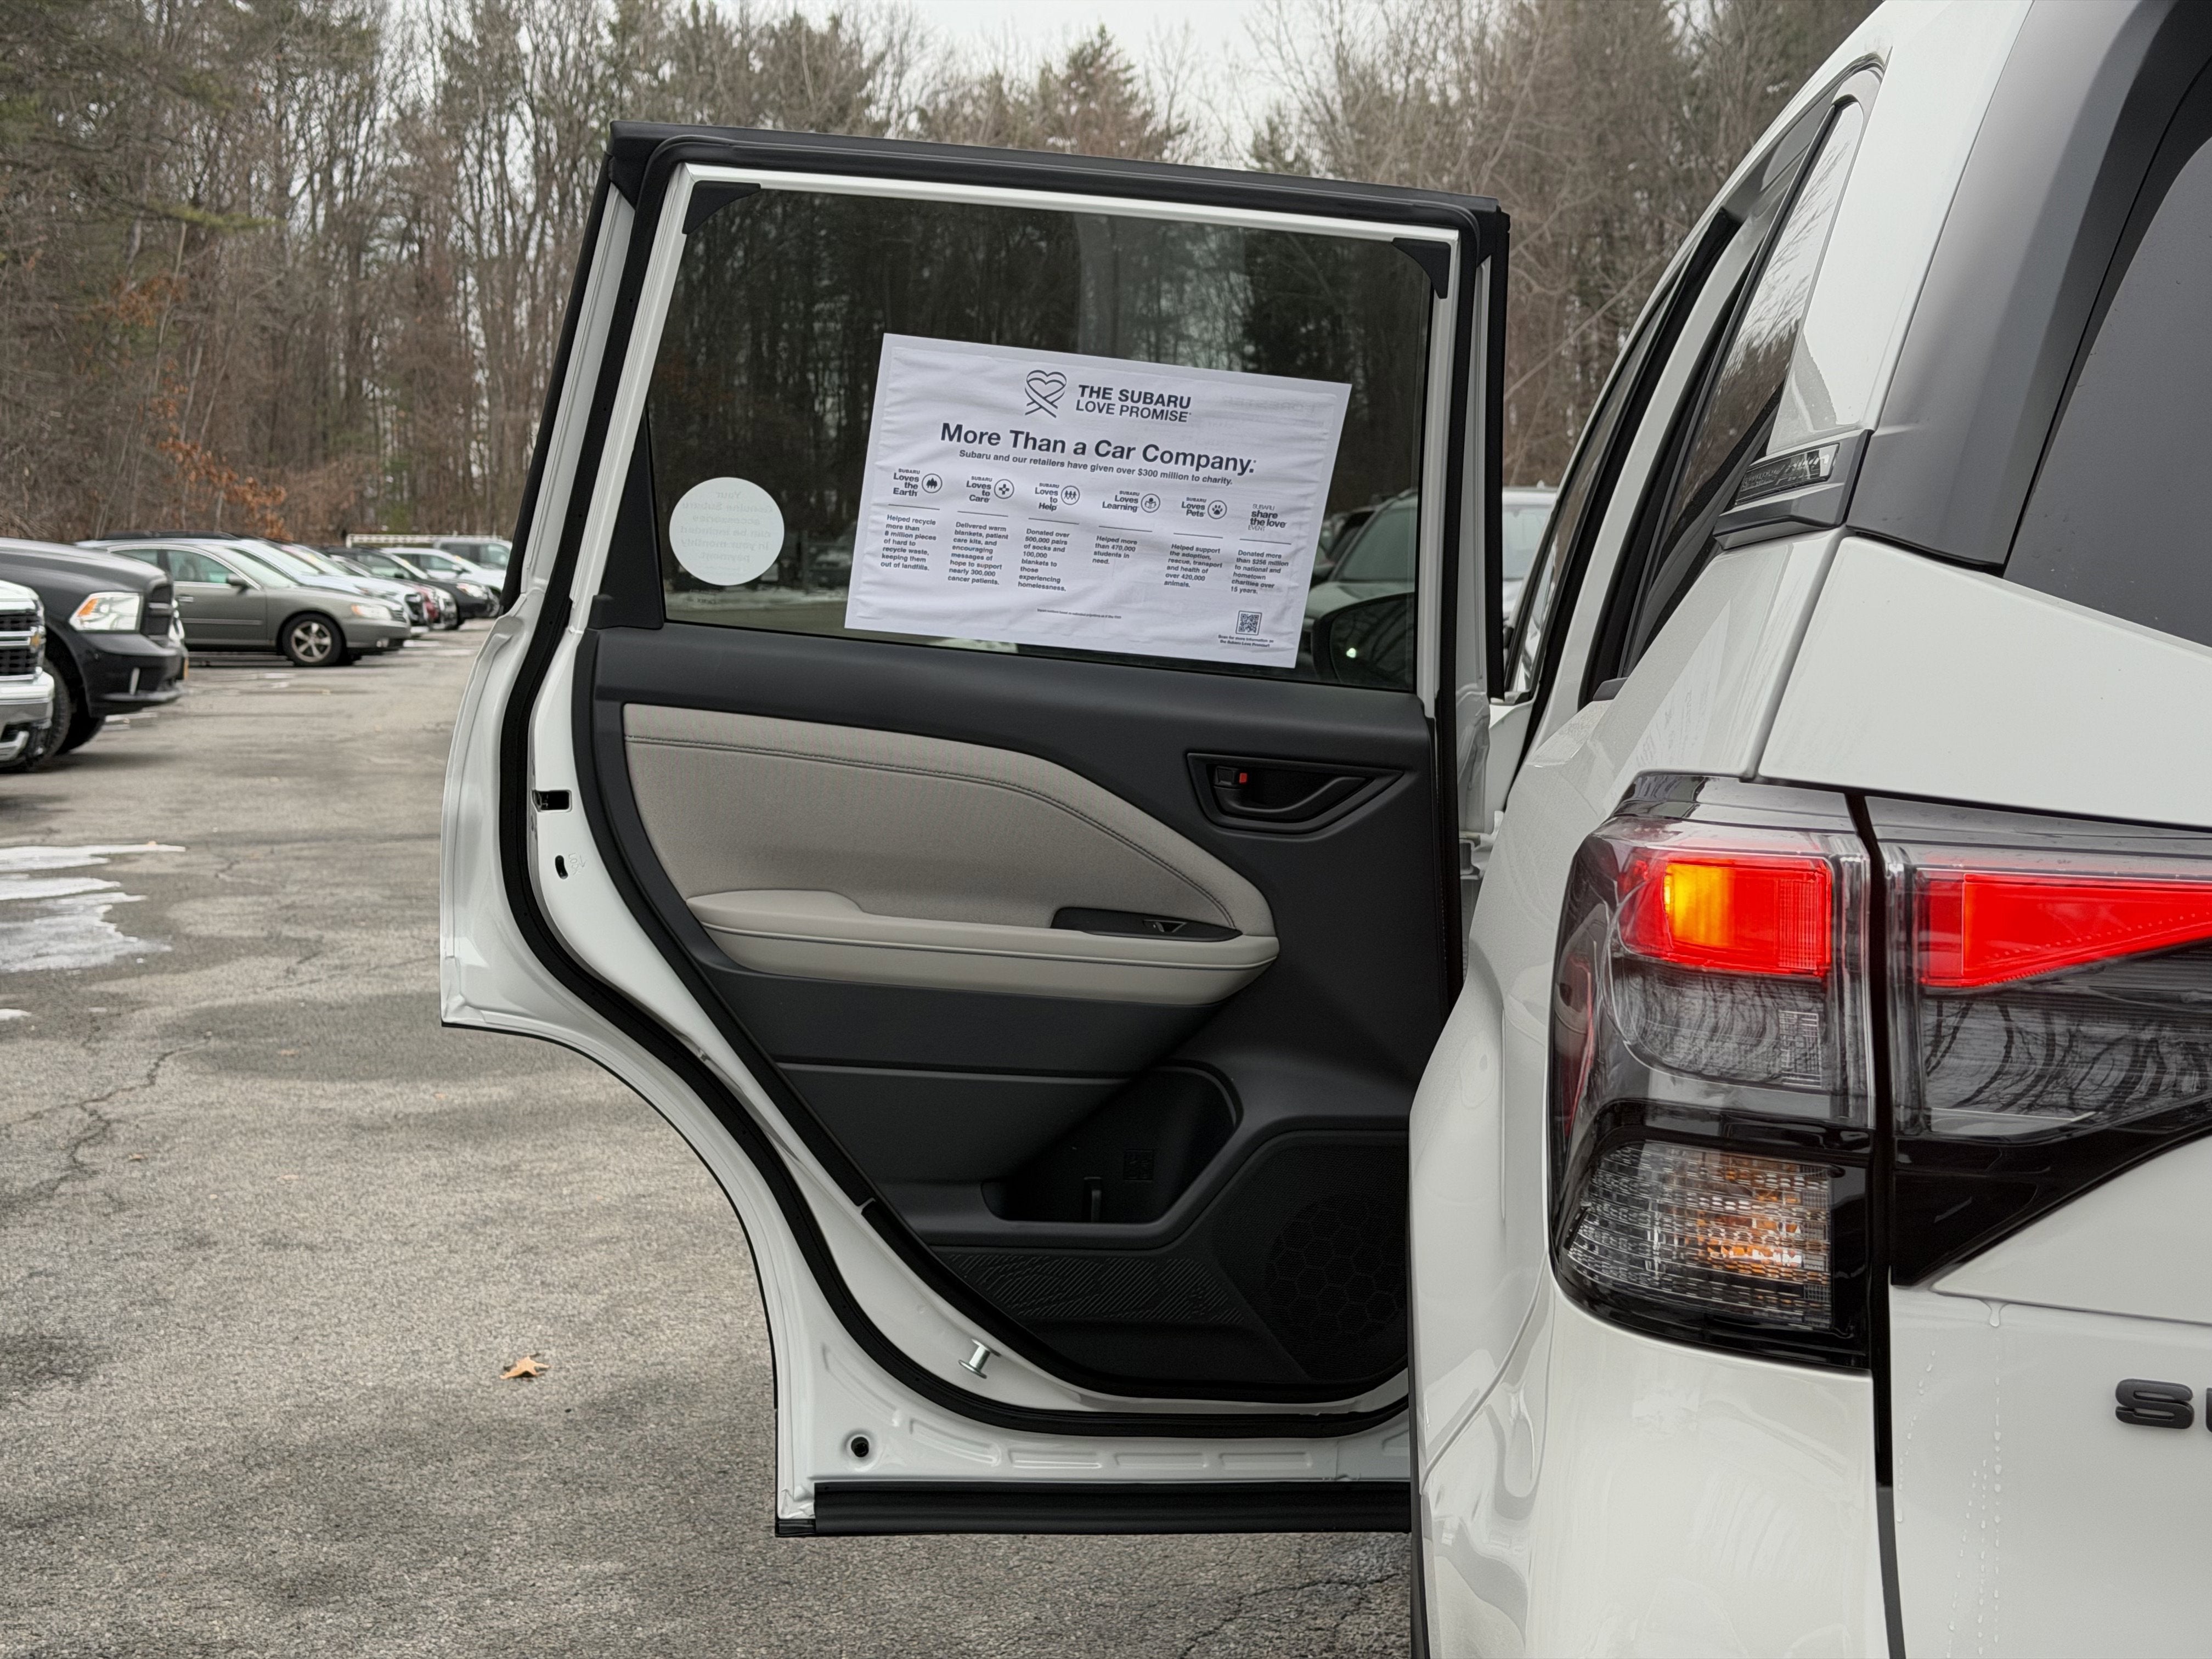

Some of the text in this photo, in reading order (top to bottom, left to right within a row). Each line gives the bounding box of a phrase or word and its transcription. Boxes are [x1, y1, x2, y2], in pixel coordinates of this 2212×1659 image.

[1078, 384, 1191, 409] THE SUBARU
[1075, 399, 1188, 422] LOVE PROMISE
[940, 422, 1001, 446] More
[1009, 430, 1066, 454] Than
[1073, 442, 1087, 455] a
[1094, 439, 1136, 460] Car
[959, 449, 991, 460] Subaru
[1029, 458, 1065, 467] retailers
[1066, 460, 1088, 470] have
[1090, 463, 1114, 472] given
[1116, 467, 1136, 475] over
[1137, 468, 1158, 477] $300
[1160, 471, 1189, 481] million
[1201, 475, 1232, 486] charity.
[893, 472, 919, 482] Loves
[904, 481, 918, 489] the
[966, 480, 991, 490] Loves
[893, 487, 918, 497] Earth
[1035, 487, 1058, 496] Loves
[969, 494, 990, 503] Care
[1114, 494, 1138, 504] Loves
[1038, 502, 1057, 512] Help
[1102, 501, 1139, 513] Learning
[1181, 501, 1205, 510] Loves
[1186, 509, 1205, 517] Pets
[1251, 510, 1278, 519] share
[887, 514, 911, 523] Helped
[1250, 517, 1287, 528] the love
[955, 521, 987, 530] Delivered
[954, 529, 984, 538] blankets,
[1026, 528, 1054, 537] Donated
[1025, 535, 1050, 544] 500,000
[1096, 535, 1120, 543] Helped
[952, 545, 994, 555] encouraging
[1171, 543, 1194, 551] Helped
[881, 552, 908, 562] keeping
[951, 552, 984, 561] messages
[1181, 552, 1211, 561] adoption,
[1238, 549, 1265, 557] Donated
[901, 562, 929, 571] landfills.
[950, 559, 967, 567] hope
[1021, 558, 1049, 566] blankets
[1193, 560, 1223, 568] transport
[1019, 574, 1061, 584] experiencing
[1181, 573, 1205, 582] 420,000
[1233, 571, 1266, 580] hometown
[1018, 581, 1066, 591] homelessness.
[1231, 579, 1259, 587] charities
[568, 852, 580, 876] LOCK
[2115, 1378, 2212, 1433] S
